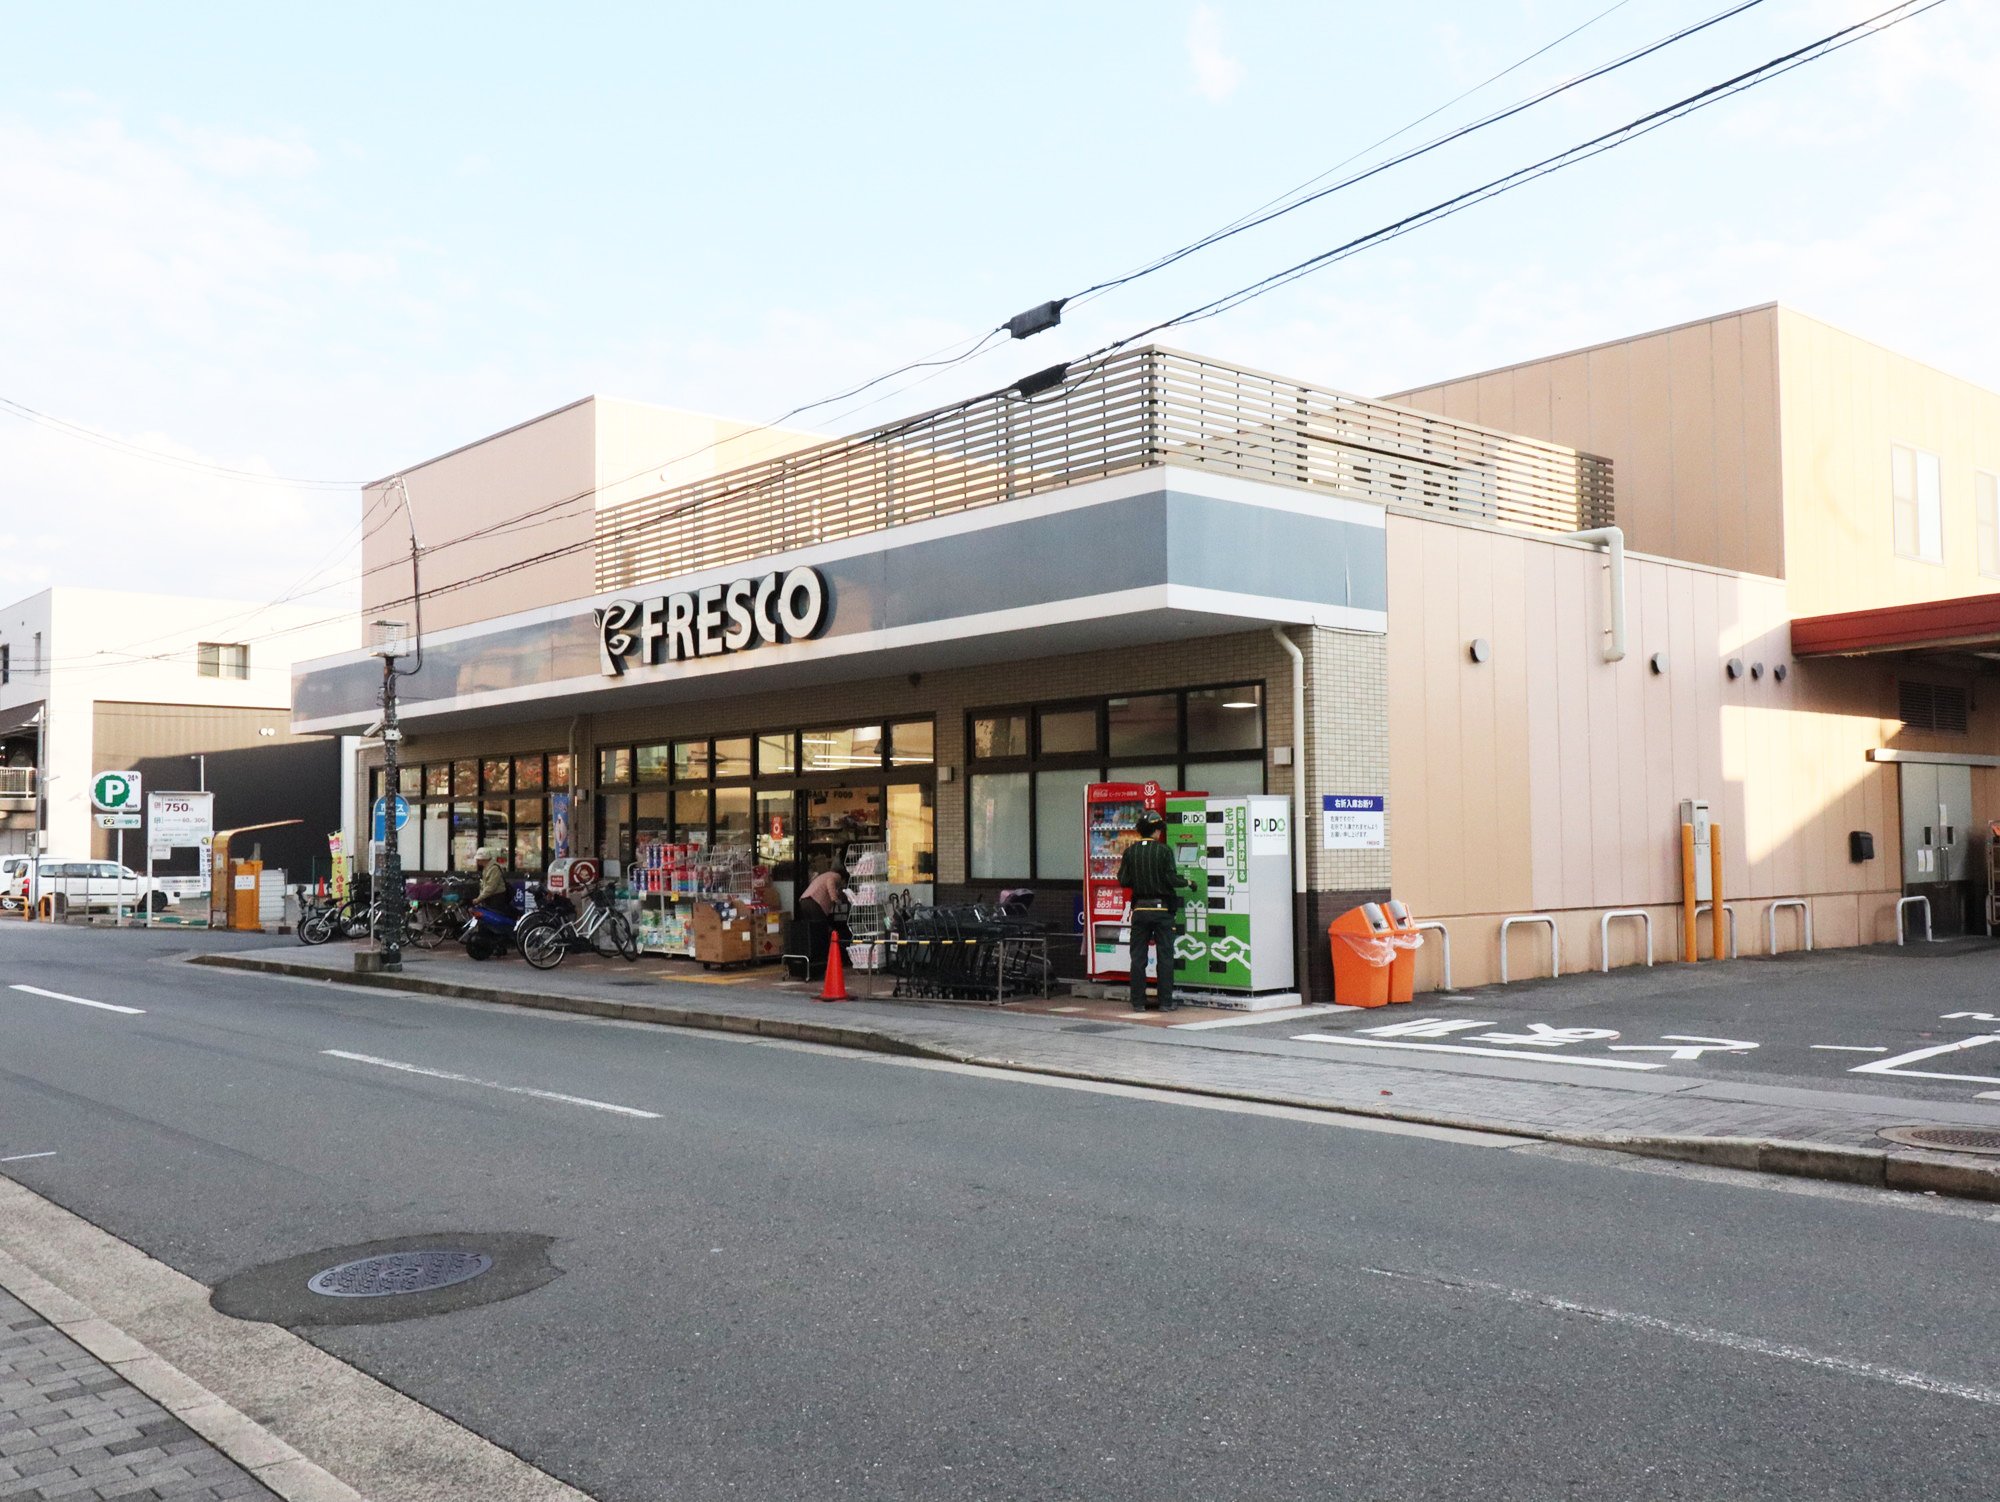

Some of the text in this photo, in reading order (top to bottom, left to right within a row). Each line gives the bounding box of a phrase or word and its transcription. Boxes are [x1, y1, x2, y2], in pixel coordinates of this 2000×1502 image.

[641, 565, 829, 665] FRESCO
[105, 779, 125, 804] P
[1183, 814, 1205, 823] PUDO
[1253, 818, 1286, 832] PUDO
[1225, 807, 1235, 911] 宅配便ロッカー
